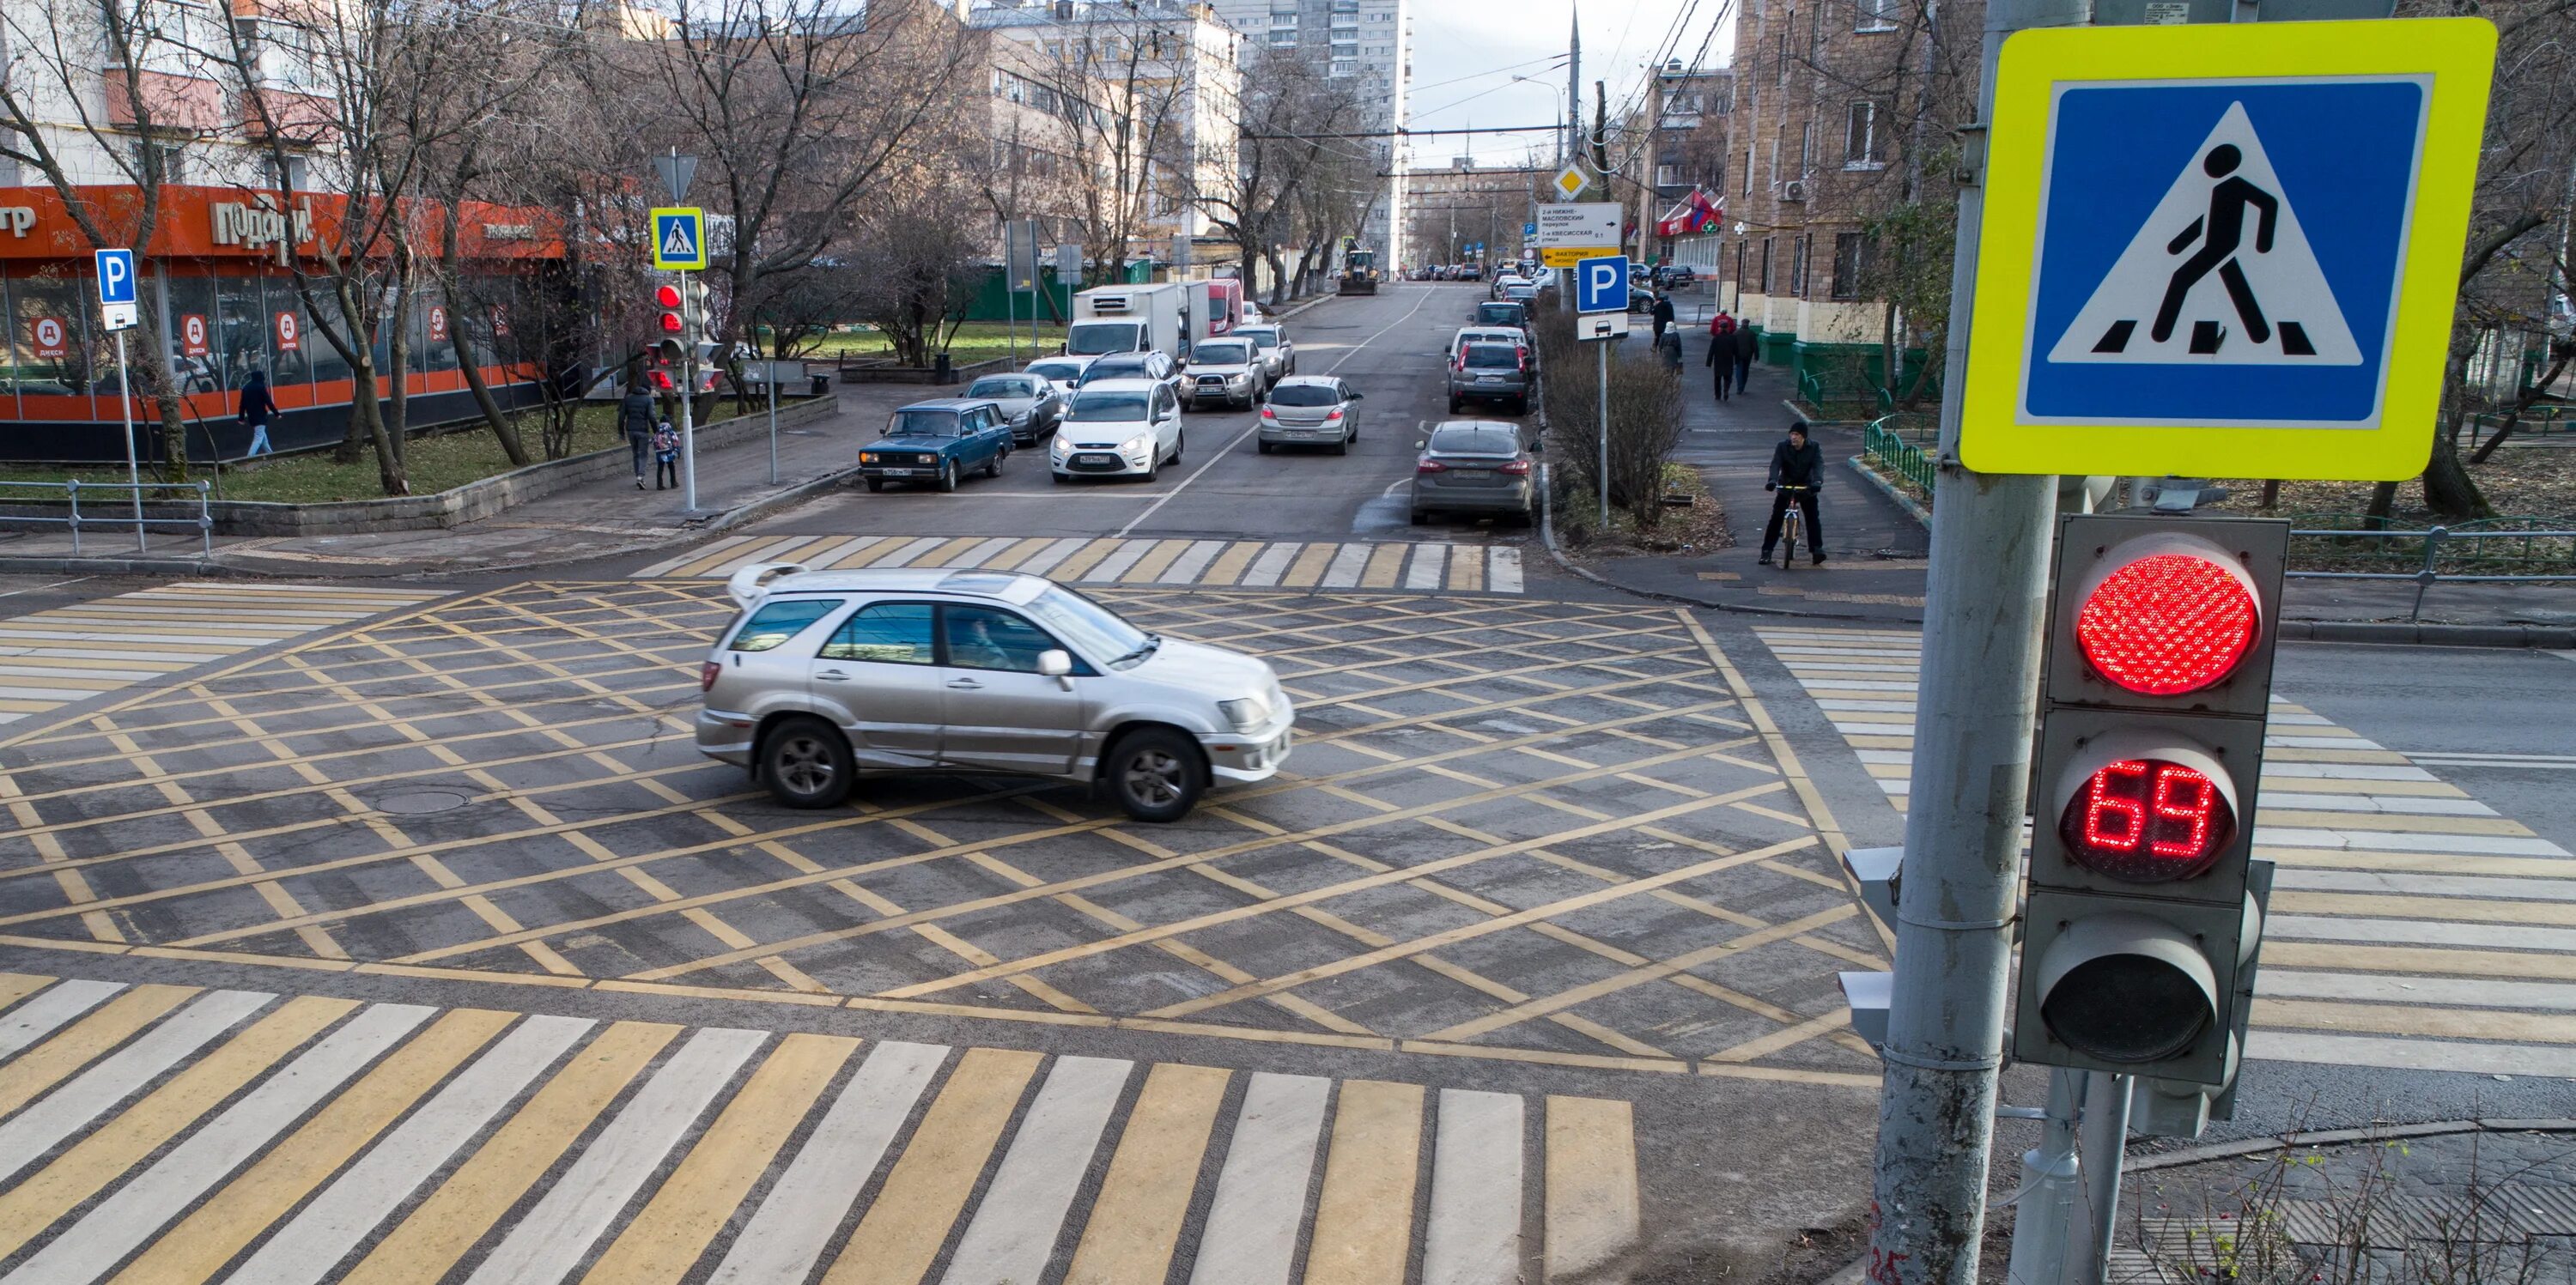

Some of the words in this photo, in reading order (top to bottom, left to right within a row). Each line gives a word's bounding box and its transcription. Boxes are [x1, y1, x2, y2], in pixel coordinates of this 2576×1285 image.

[105, 257, 125, 296] P
[1591, 264, 1617, 305] P
[2086, 759, 2213, 858] 69
